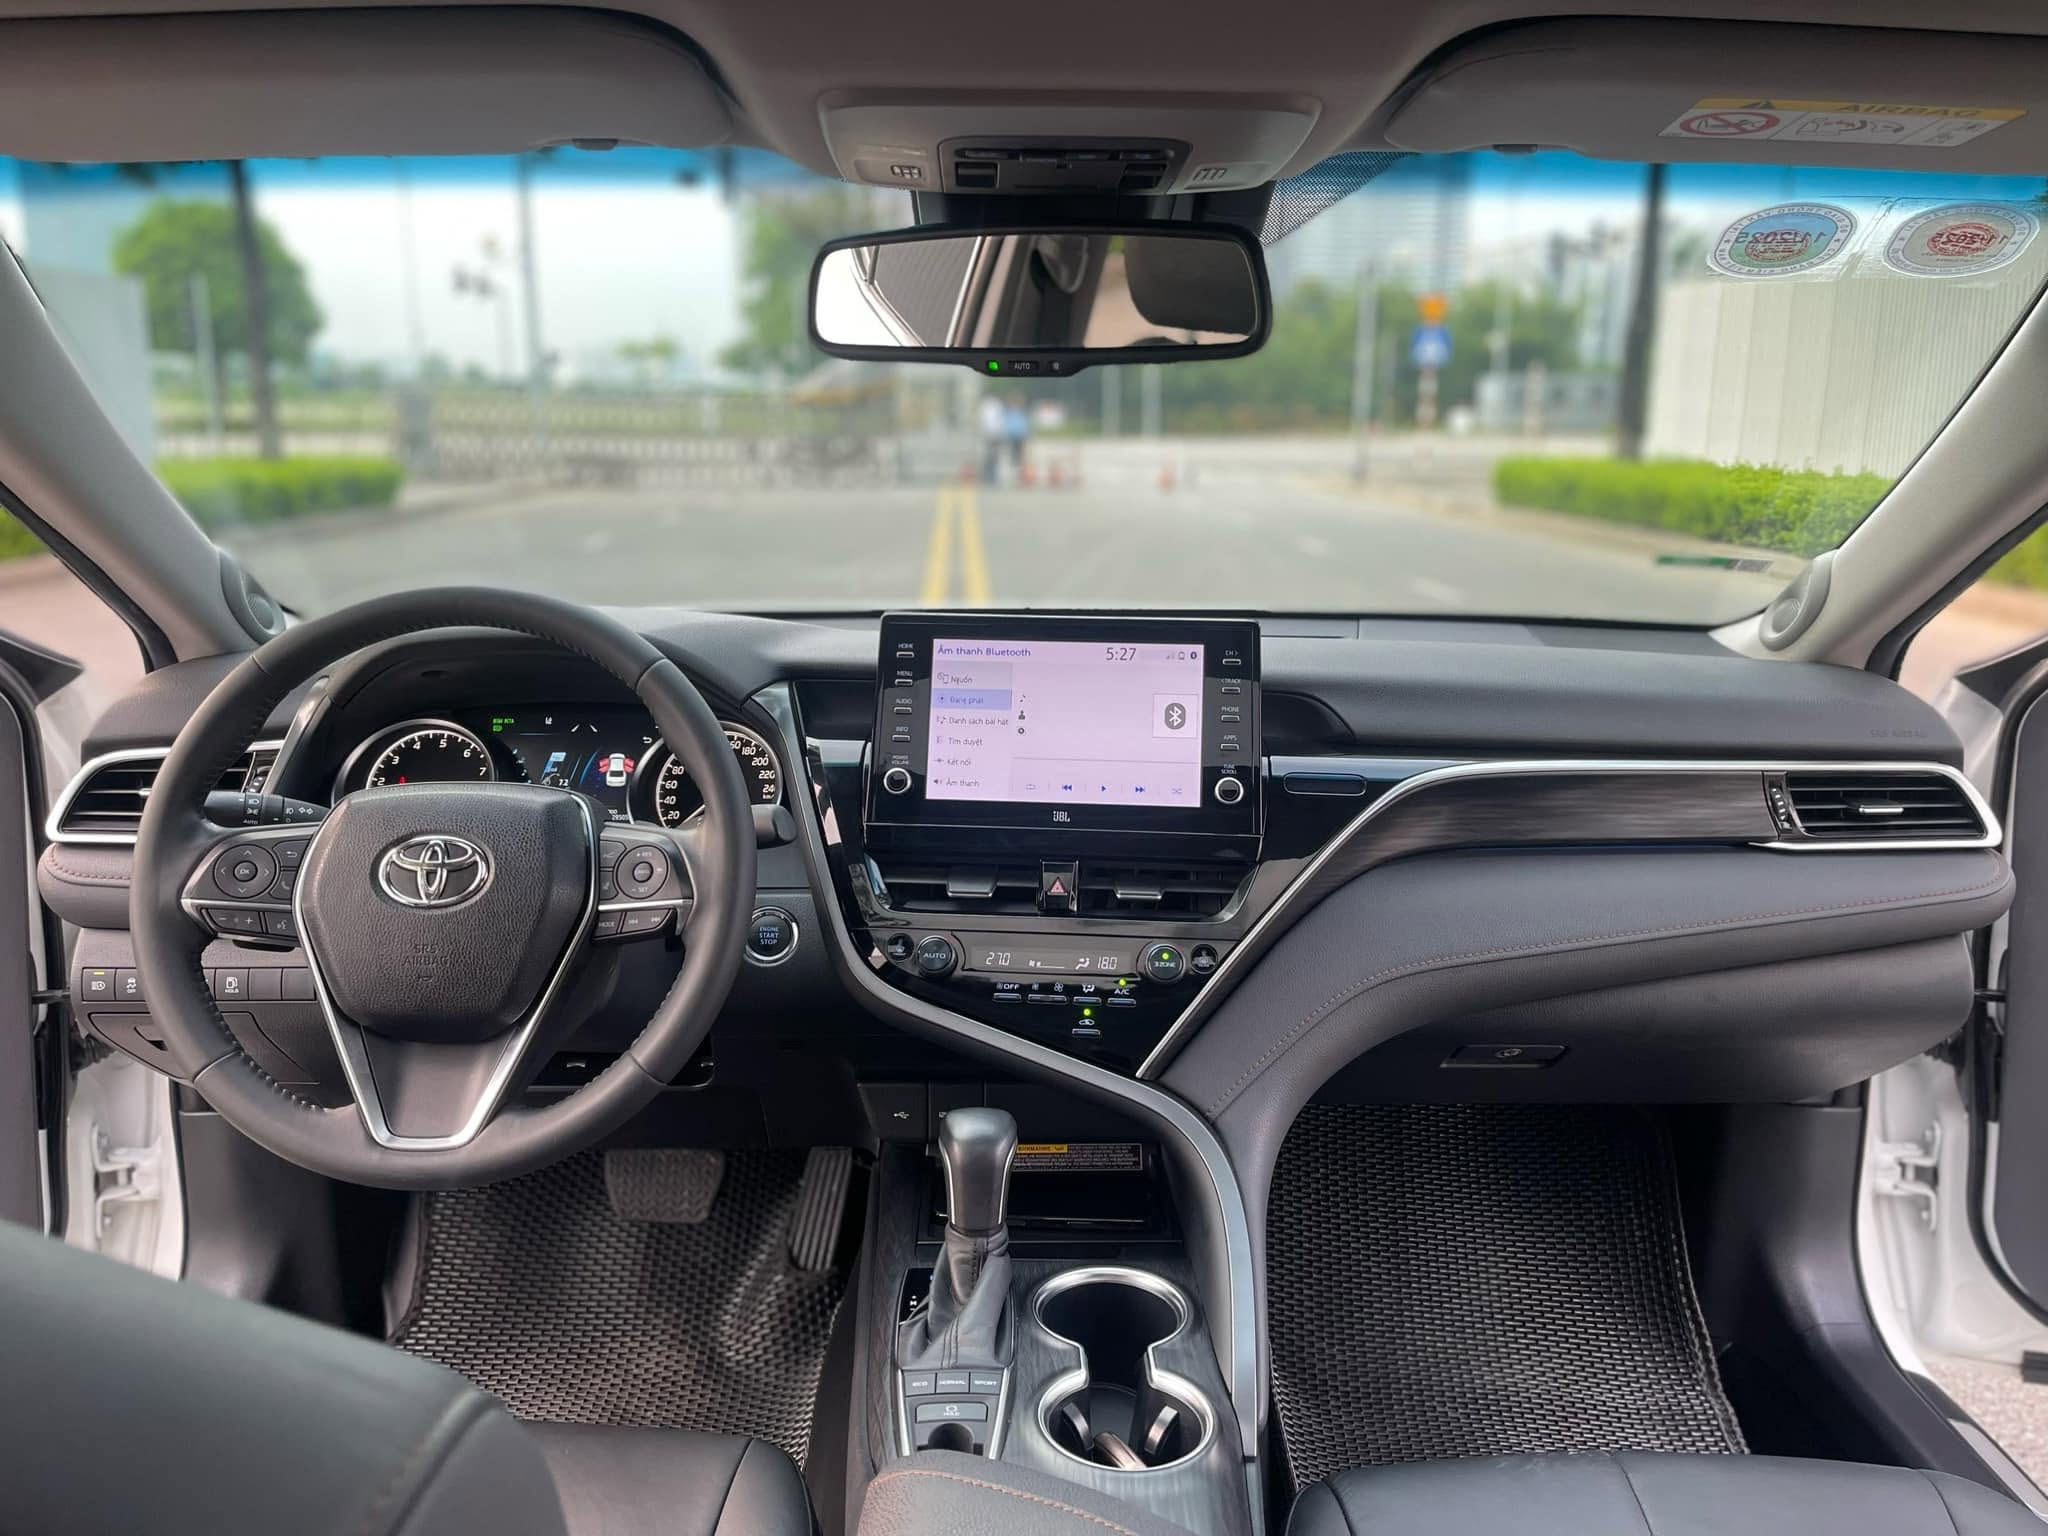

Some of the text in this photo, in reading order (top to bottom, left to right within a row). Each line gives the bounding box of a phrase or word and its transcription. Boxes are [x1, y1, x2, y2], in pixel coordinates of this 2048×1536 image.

[1839, 104, 1981, 117] AIRBAG
[1014, 362, 1030, 370] AUTO
[956, 646, 983, 656] thanh
[985, 647, 1031, 657] Bluetooth
[1105, 647, 1137, 661] 5:27
[413, 741, 421, 750] 4
[439, 739, 447, 748] 5
[463, 749, 471, 758] 6
[742, 747, 756, 756] 180
[391, 756, 399, 765] 3
[751, 757, 768, 767] 200
[479, 767, 487, 776] 7
[672, 766, 684, 775] 80
[758, 770, 775, 780] 220
[377, 777, 385, 786] 2
[665, 780, 678, 790] 60
[664, 796, 676, 805] 40
[667, 811, 680, 820] 20
[1053, 810, 1071, 823] JBL
[239, 867, 250, 875] OK
[1003, 983, 1020, 991] OFF
